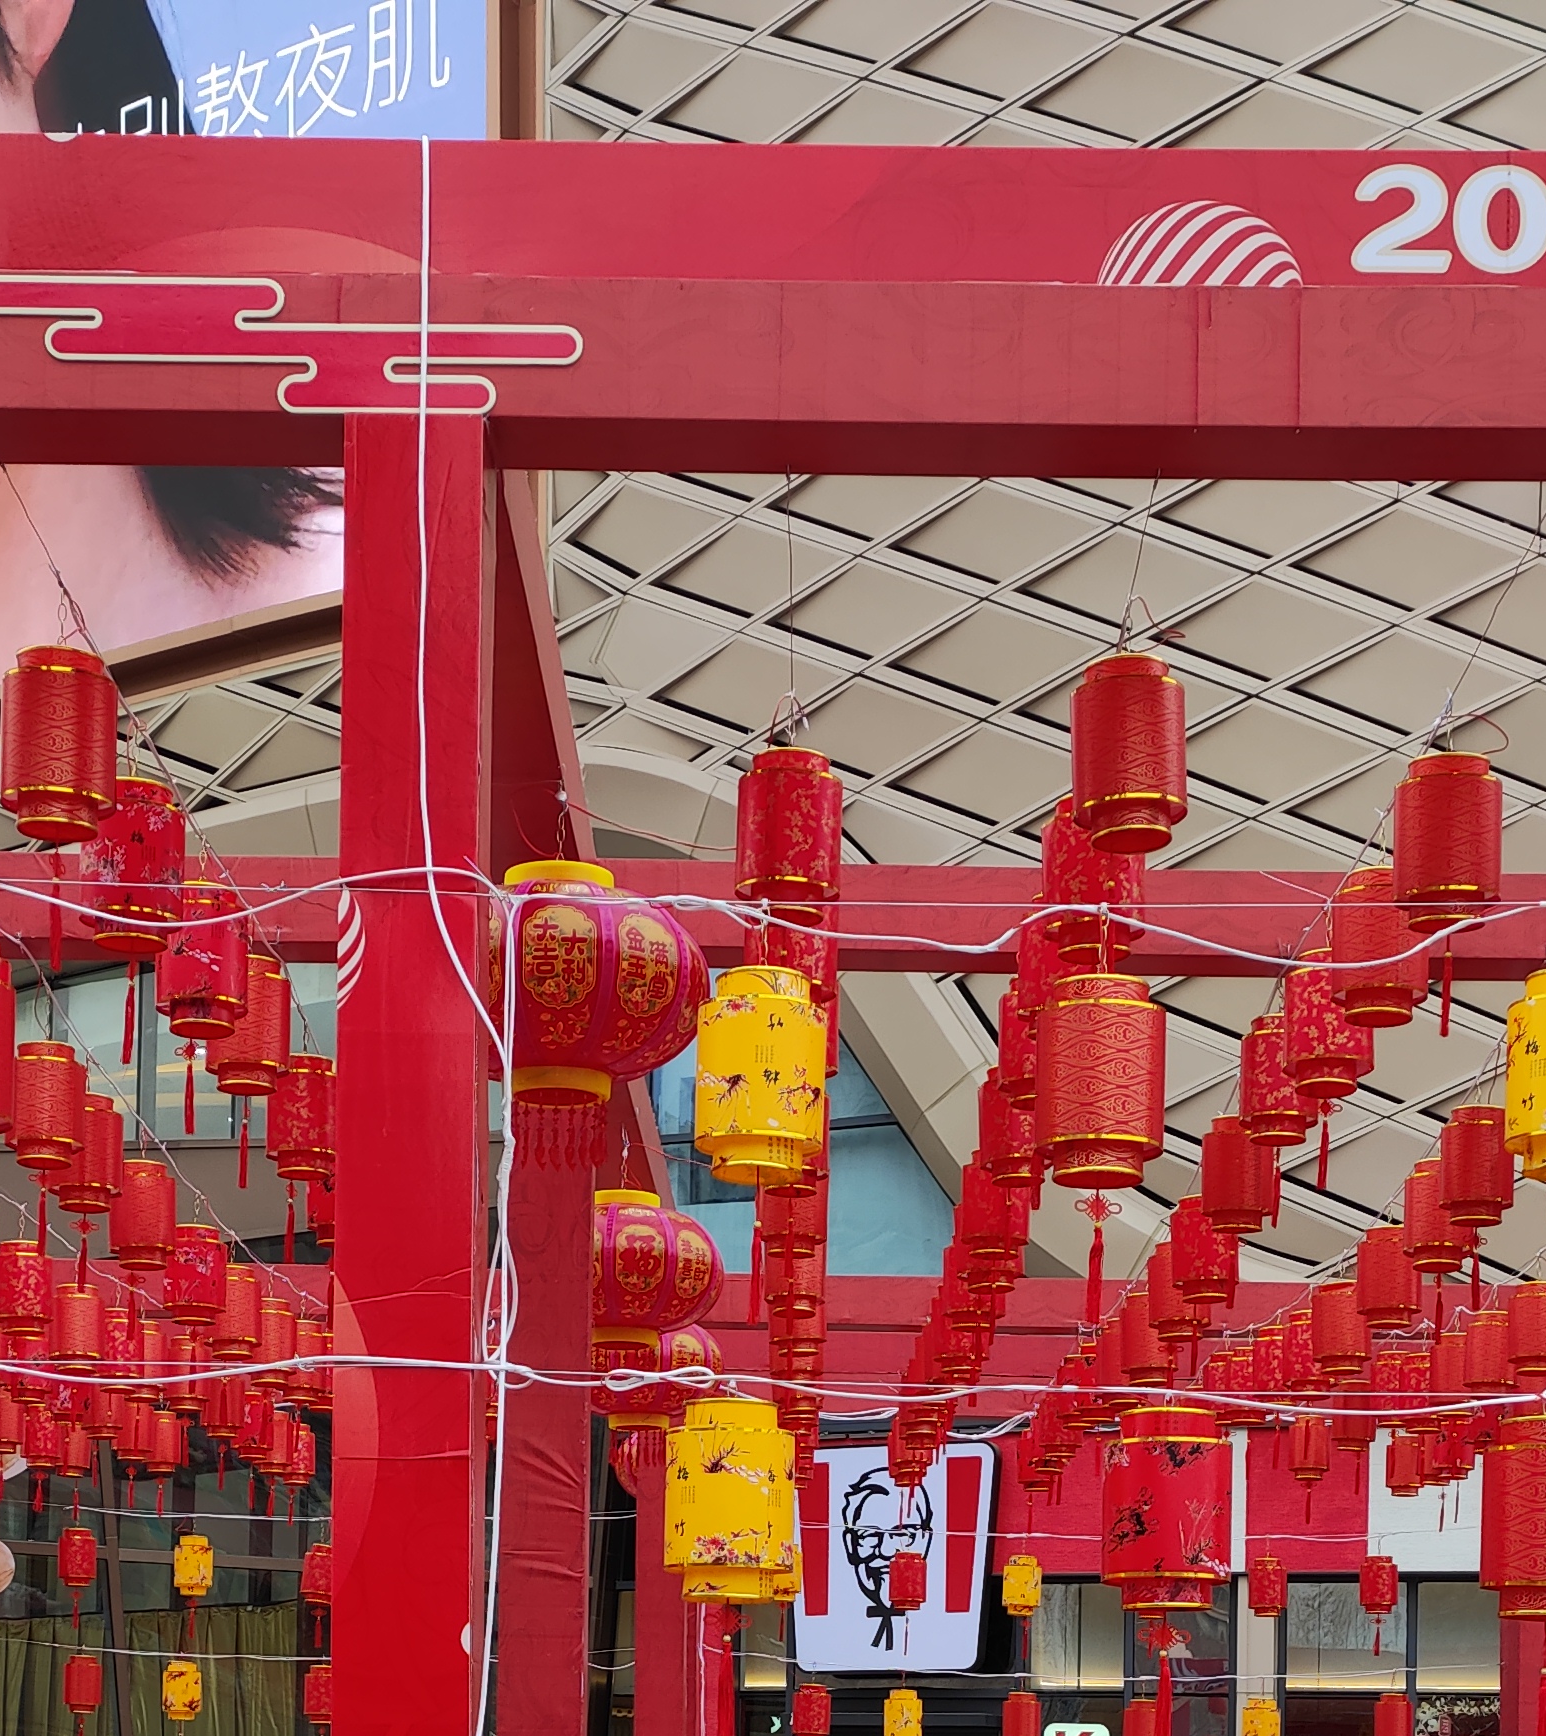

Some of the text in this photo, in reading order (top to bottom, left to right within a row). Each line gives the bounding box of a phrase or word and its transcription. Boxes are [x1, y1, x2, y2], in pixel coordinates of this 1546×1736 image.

[75, 0, 451, 137] 别熬夜肌
[1524, 1035, 1539, 1055] 梅
[1522, 1092, 1535, 1111] 竹
[619, 1234, 662, 1276] 福
[677, 1461, 689, 1481] 梅
[674, 1521, 685, 1536] 竹
